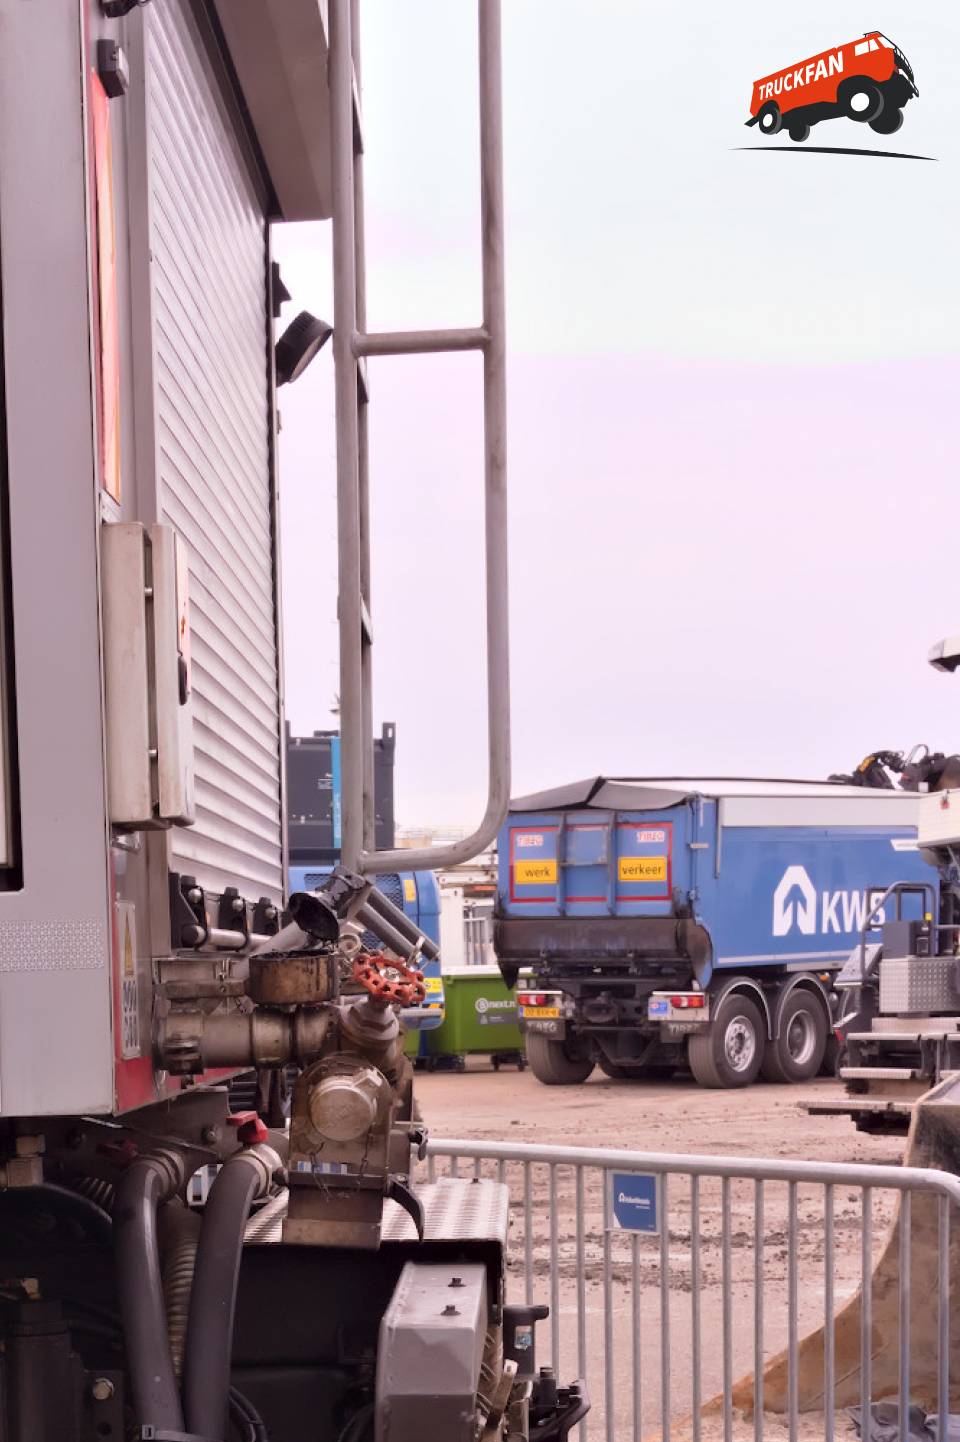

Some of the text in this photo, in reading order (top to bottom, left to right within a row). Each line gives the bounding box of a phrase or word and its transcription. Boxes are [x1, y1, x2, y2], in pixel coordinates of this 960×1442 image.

[525, 866, 551, 878] werk
[621, 862, 662, 876] verkeer
[821, 890, 886, 933] KWS
